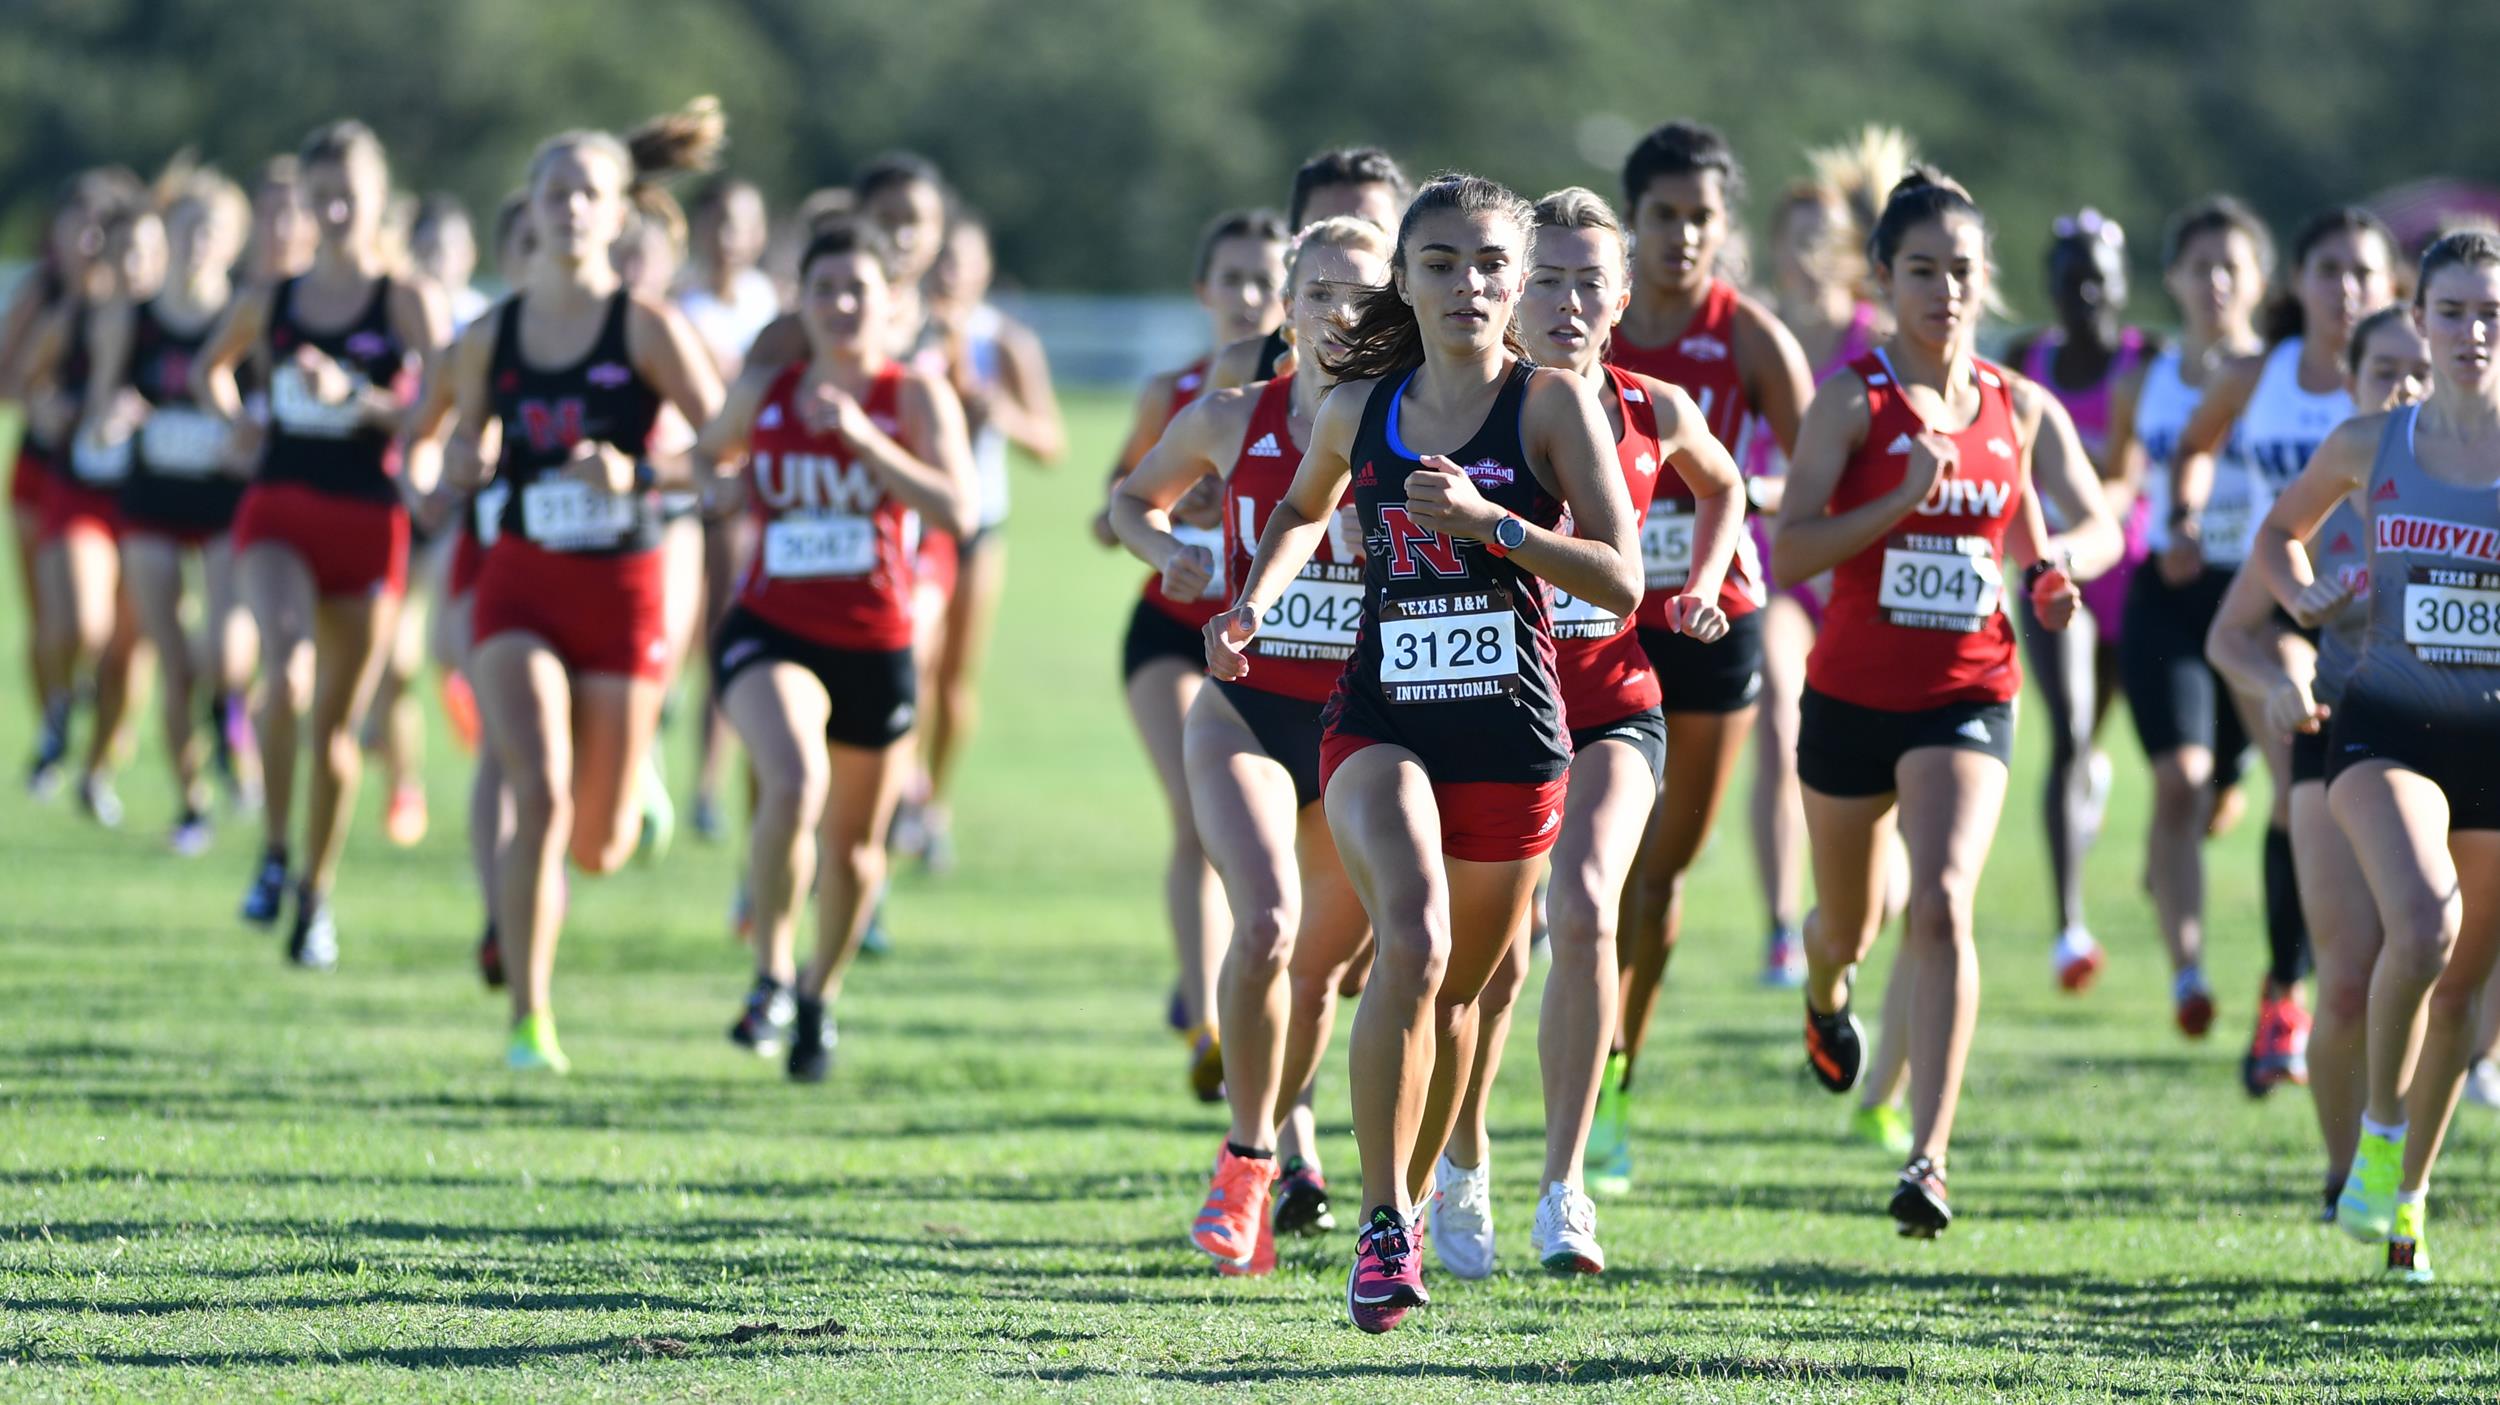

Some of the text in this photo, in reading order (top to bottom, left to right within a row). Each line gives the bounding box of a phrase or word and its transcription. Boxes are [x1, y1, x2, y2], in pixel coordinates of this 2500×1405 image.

[754, 453, 877, 512] UIW
[1463, 466, 1514, 482] SOUTHLAND
[1377, 503, 1470, 581] N
[1641, 525, 1690, 563] 45
[2378, 516, 2500, 567] LOUISVIL
[2429, 569, 2500, 588] TEXAS A&
[1398, 594, 1489, 616] TEXAS A&M
[1259, 639, 1355, 661] INVITATIONA
[1394, 625, 1502, 670] 3128
[1396, 679, 1503, 701] INVITATIONAL
